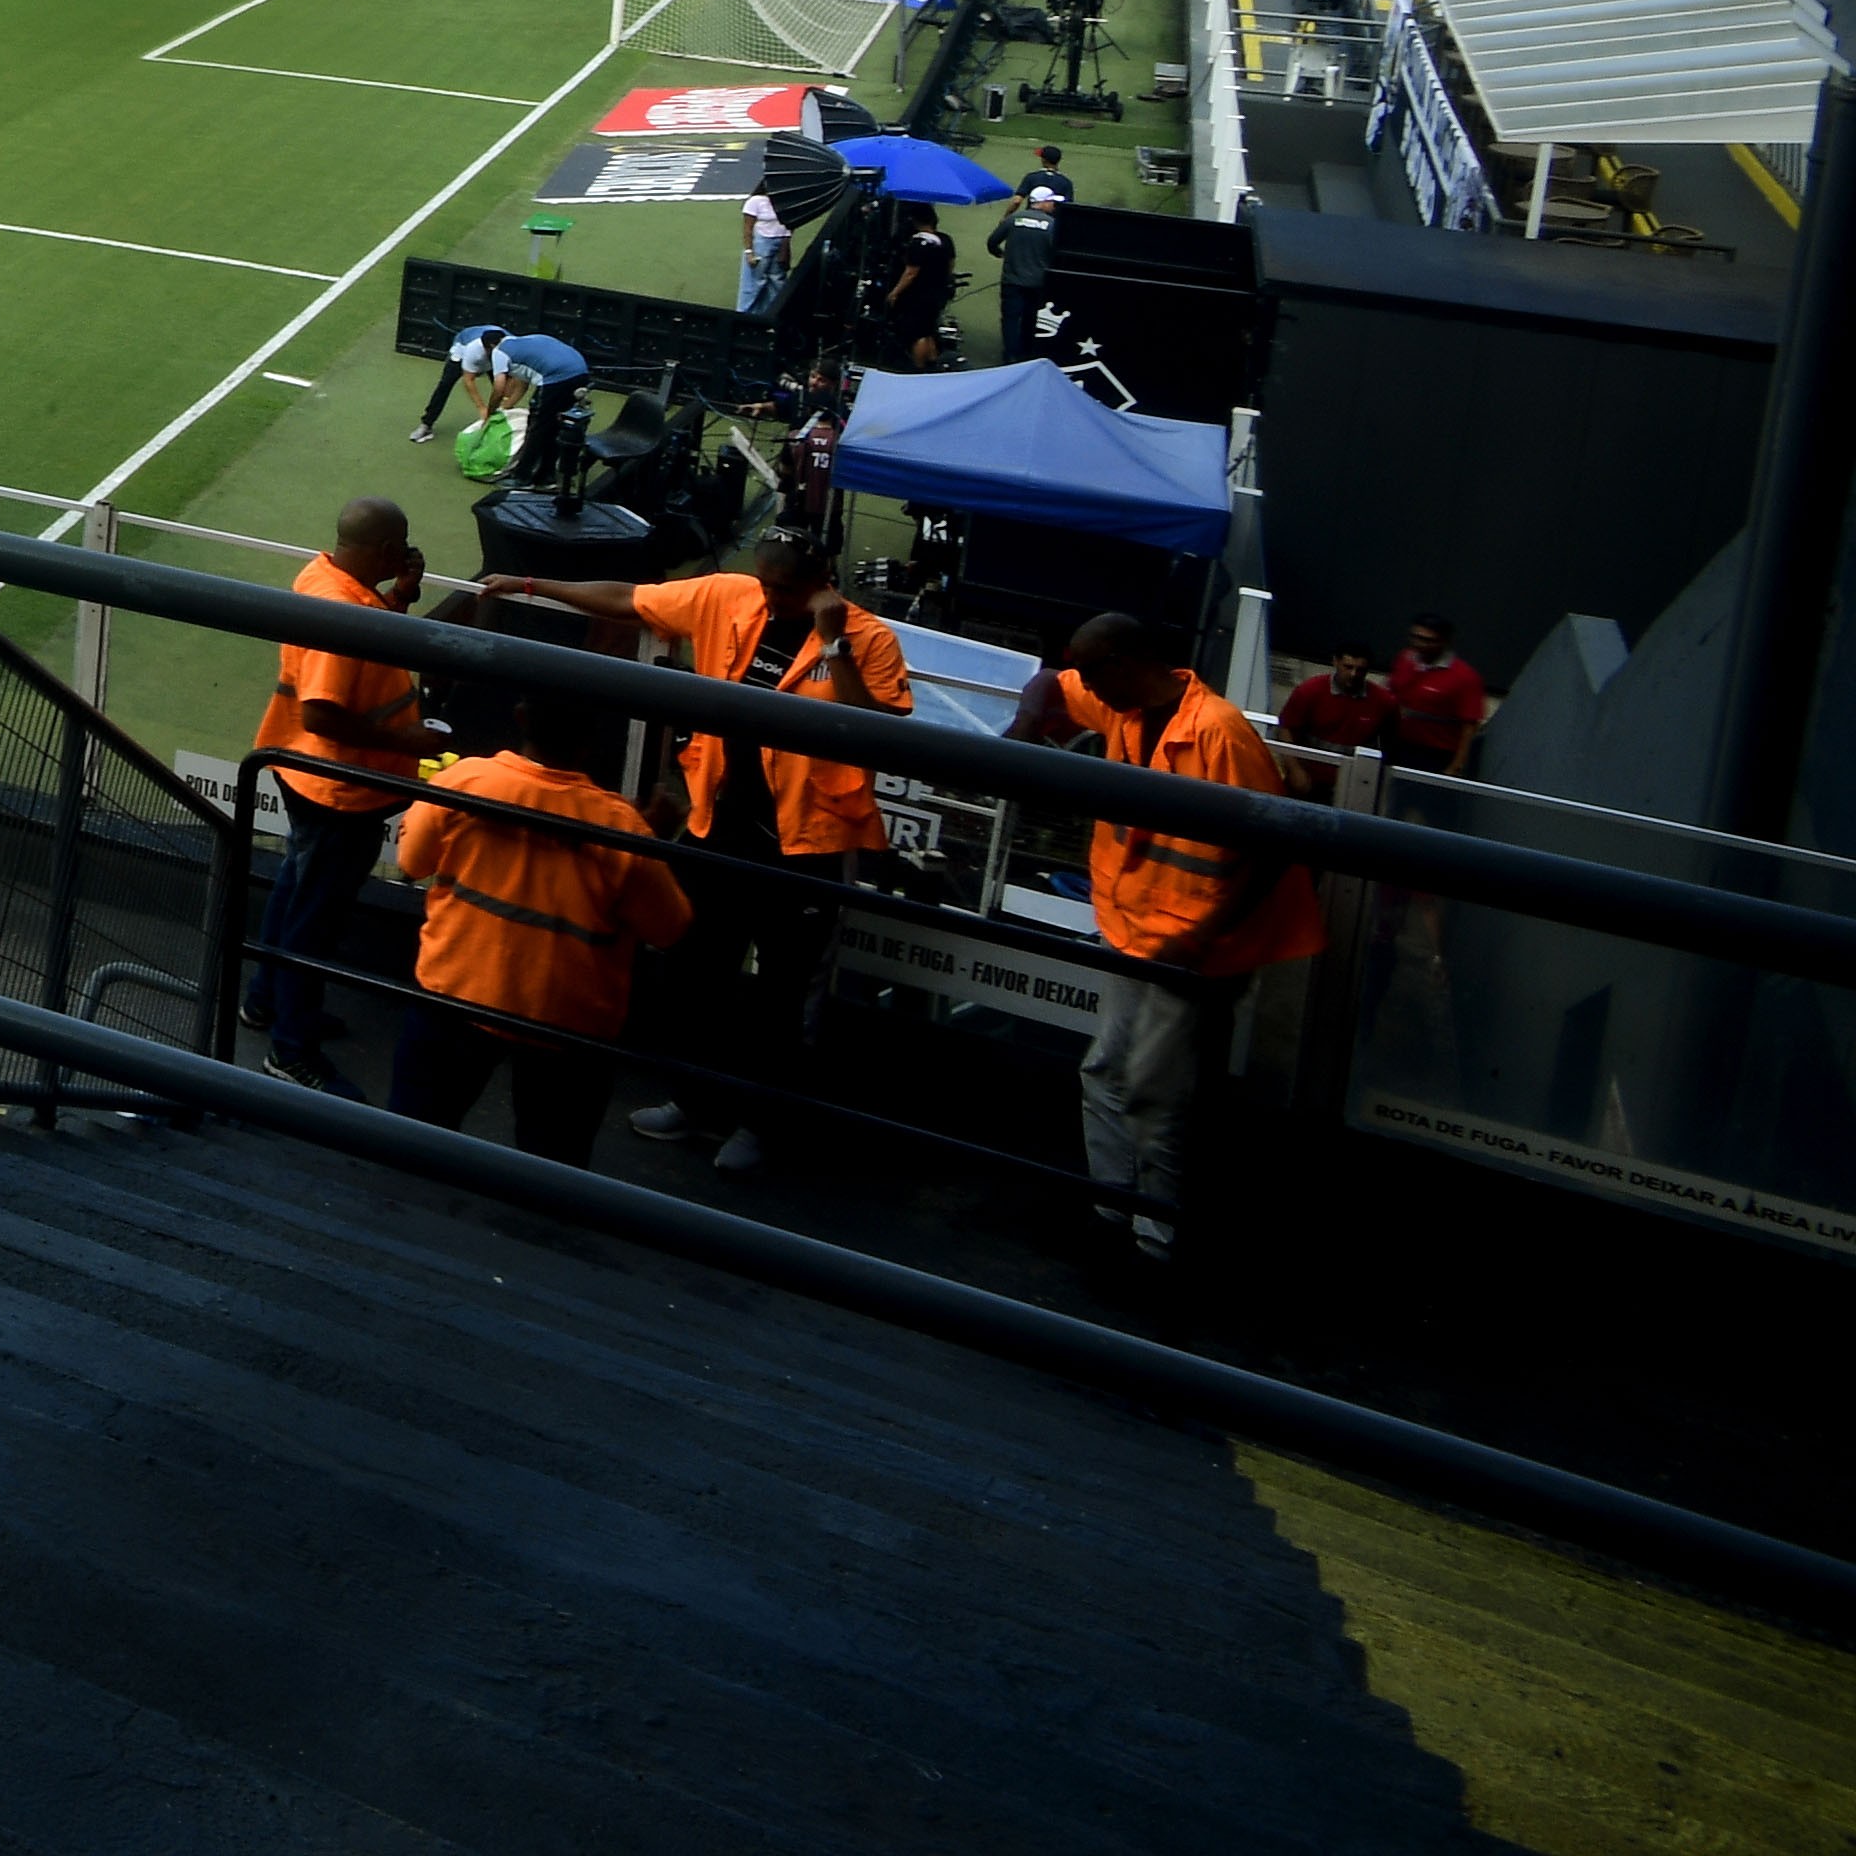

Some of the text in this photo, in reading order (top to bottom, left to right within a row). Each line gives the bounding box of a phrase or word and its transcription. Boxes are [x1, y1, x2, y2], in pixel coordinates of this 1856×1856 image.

[185, 774, 218, 799] ROTA
[253, 791, 279, 815] UGA
[881, 937, 904, 961] DE
[907, 944, 954, 975] FUGA
[970, 960, 1028, 997] FAVOR
[1032, 976, 1100, 1015] DEIXAR
[1375, 1103, 1430, 1130] ROTA
[1435, 1119, 1465, 1139] DE
[1469, 1127, 1532, 1156] FUGA
[1547, 1149, 1625, 1181] FAVOR
[1629, 1170, 1715, 1208] DEIXAR
[1720, 1196, 1743, 1212] A
[1816, 1220, 1856, 1246] LIV
